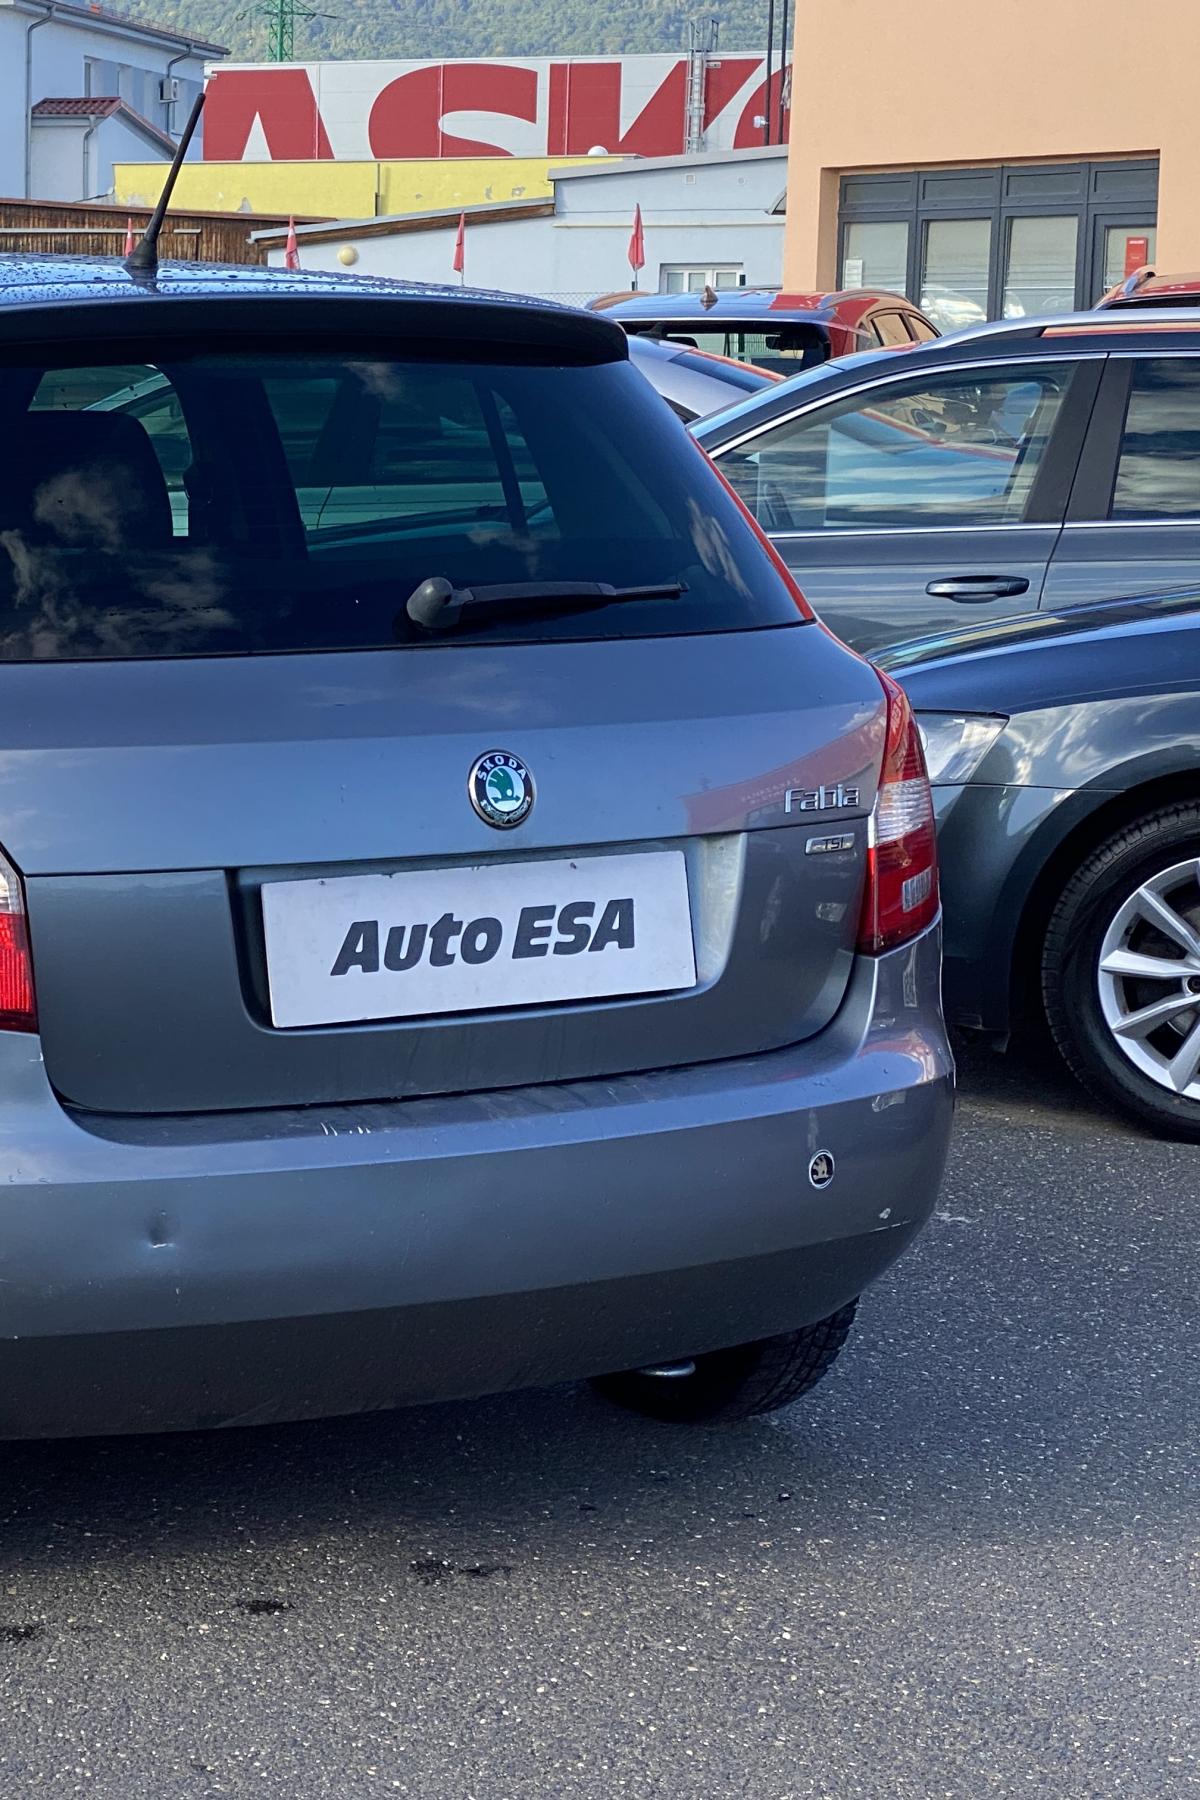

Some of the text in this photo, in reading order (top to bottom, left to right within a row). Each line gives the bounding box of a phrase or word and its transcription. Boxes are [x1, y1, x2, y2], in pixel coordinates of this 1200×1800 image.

[784, 784, 860, 813] Fabia
[823, 837, 845, 851] TSI
[330, 897, 636, 977] Auto ESA
